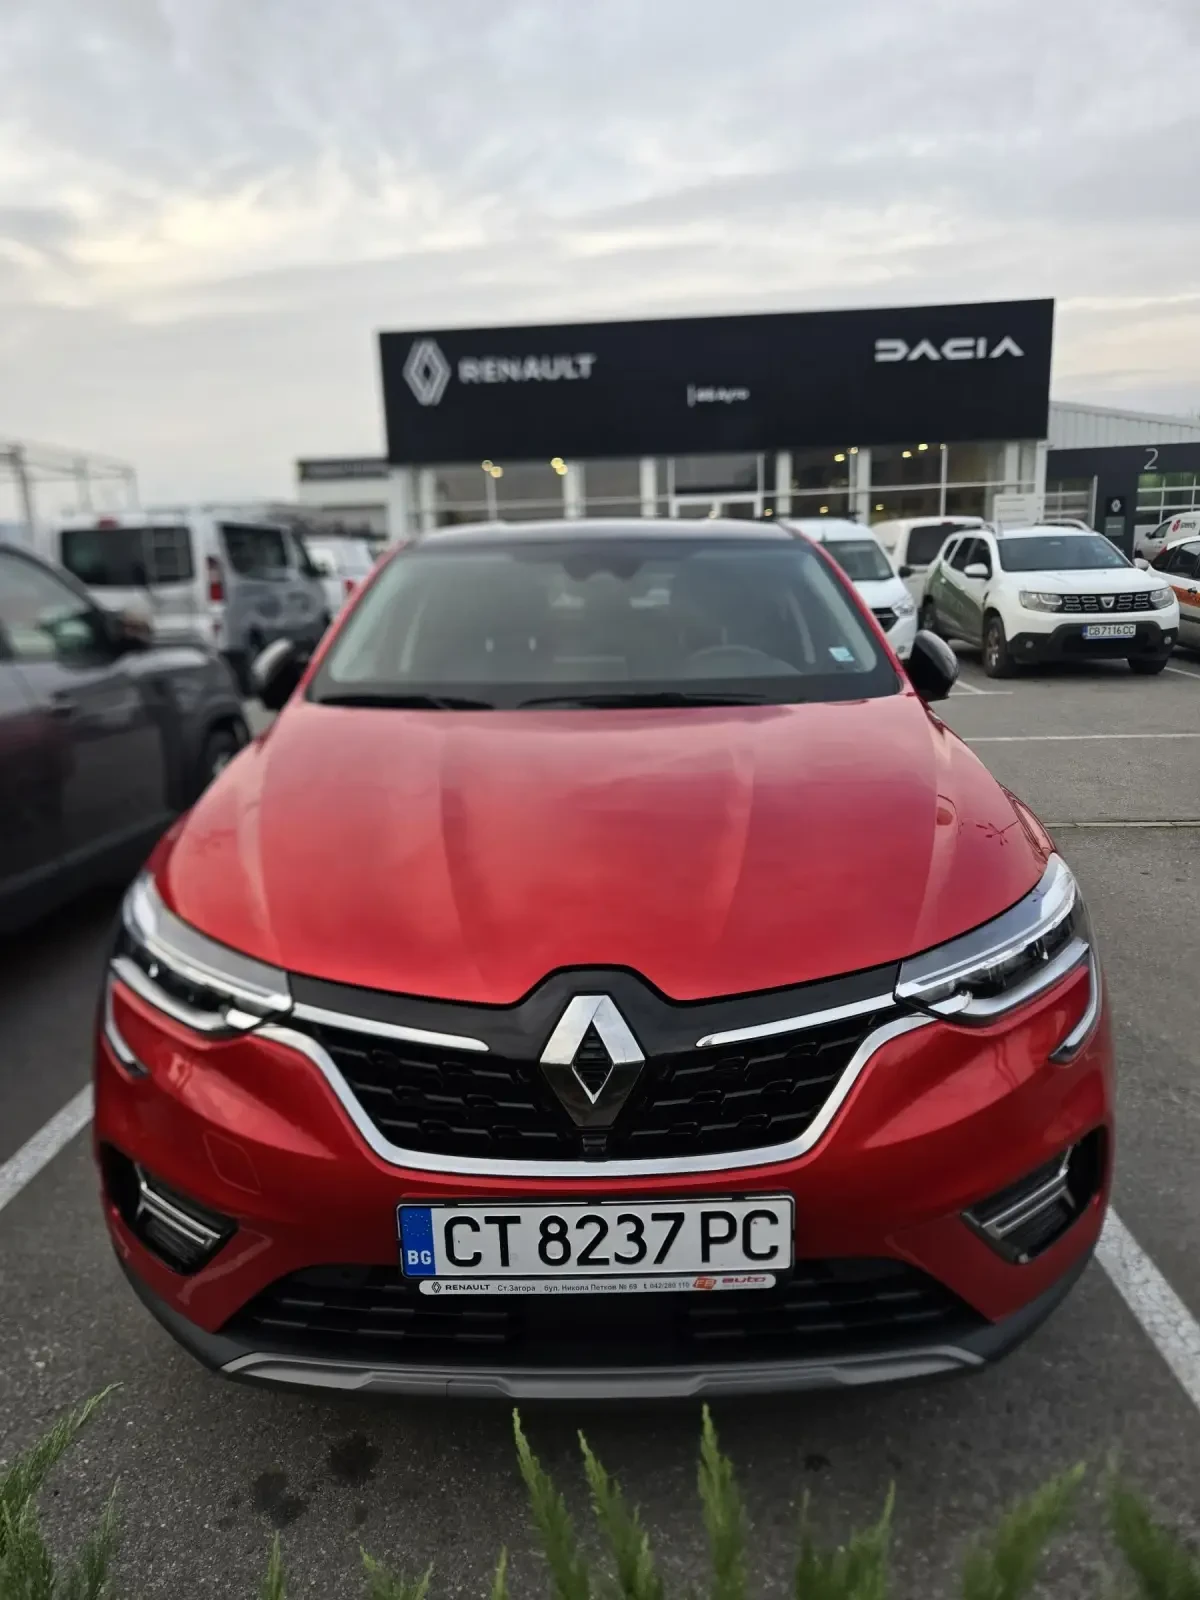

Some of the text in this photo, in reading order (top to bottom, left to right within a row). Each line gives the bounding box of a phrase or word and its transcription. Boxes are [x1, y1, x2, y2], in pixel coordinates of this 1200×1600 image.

[874, 335, 1025, 363] DACIA
[457, 353, 597, 385] RENAULT
[1143, 447, 1159, 470] 2
[443, 1209, 780, 1267] CT 8237 PC
[407, 1249, 432, 1266] BG
